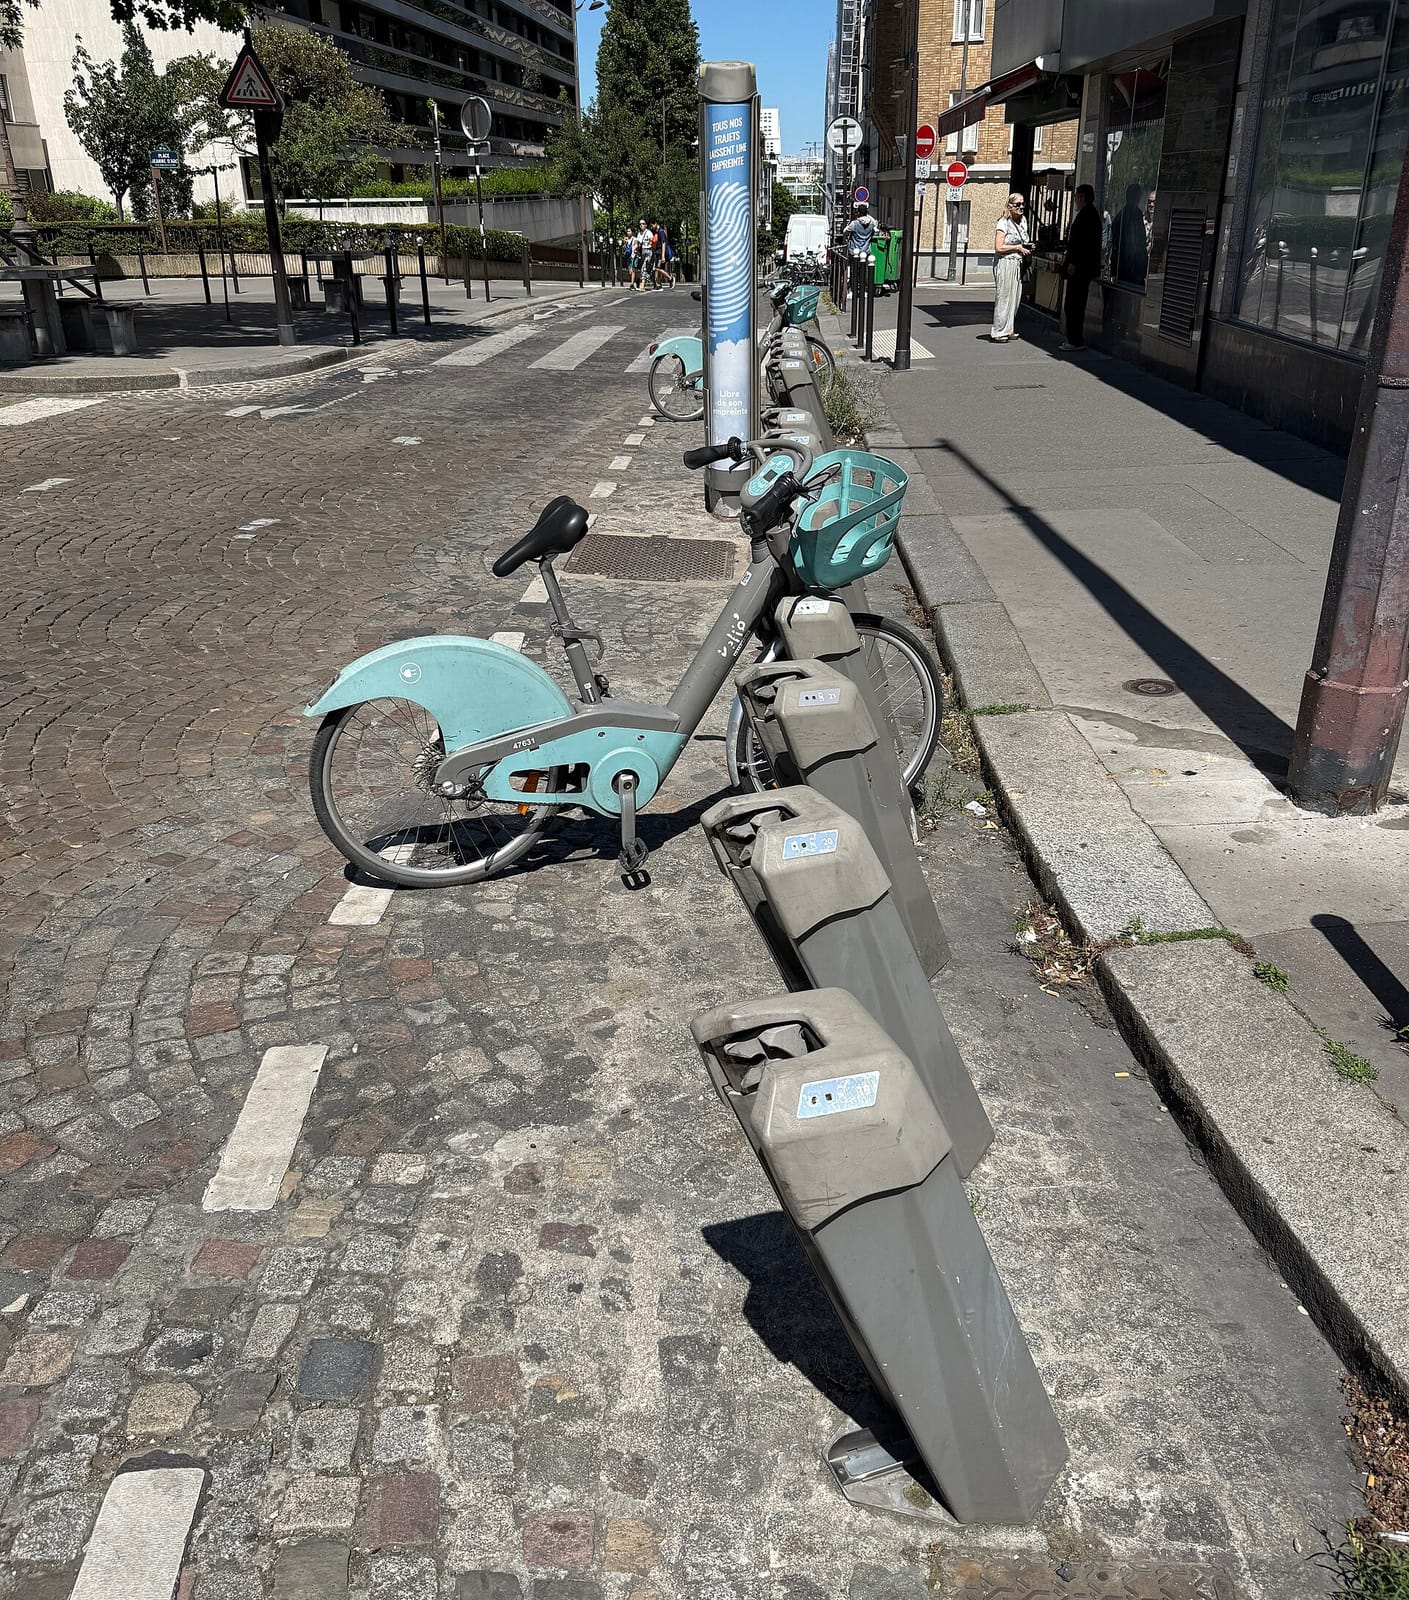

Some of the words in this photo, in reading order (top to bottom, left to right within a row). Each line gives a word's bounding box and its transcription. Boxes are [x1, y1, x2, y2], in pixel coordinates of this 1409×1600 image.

[711, 120, 729, 133] TOUS
[729, 117, 743, 129] NOS
[714, 131, 741, 145] TRAJETS
[709, 144, 735, 160] LAISSENT
[735, 142, 748, 154] UNE
[711, 156, 745, 172] EMPREINTE
[719, 390, 740, 398] Libre
[512, 737, 536, 749] 47631
[822, 837, 833, 846] 20
